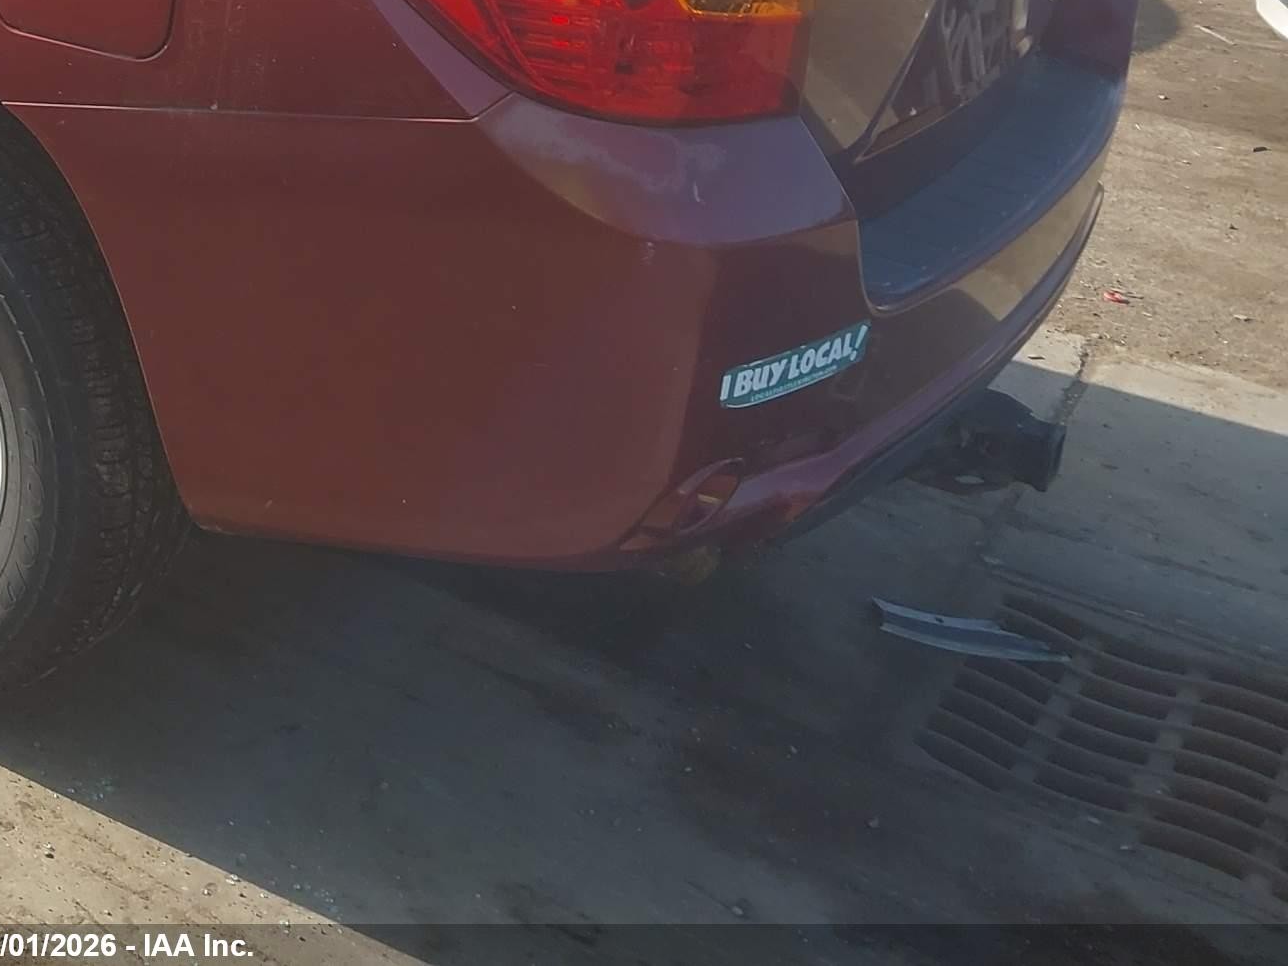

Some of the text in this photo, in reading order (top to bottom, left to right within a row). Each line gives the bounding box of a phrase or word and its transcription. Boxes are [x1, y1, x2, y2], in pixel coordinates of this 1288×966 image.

[719, 374, 732, 402] I
[734, 359, 788, 397] BUY
[788, 324, 868, 380] LOCAL!
